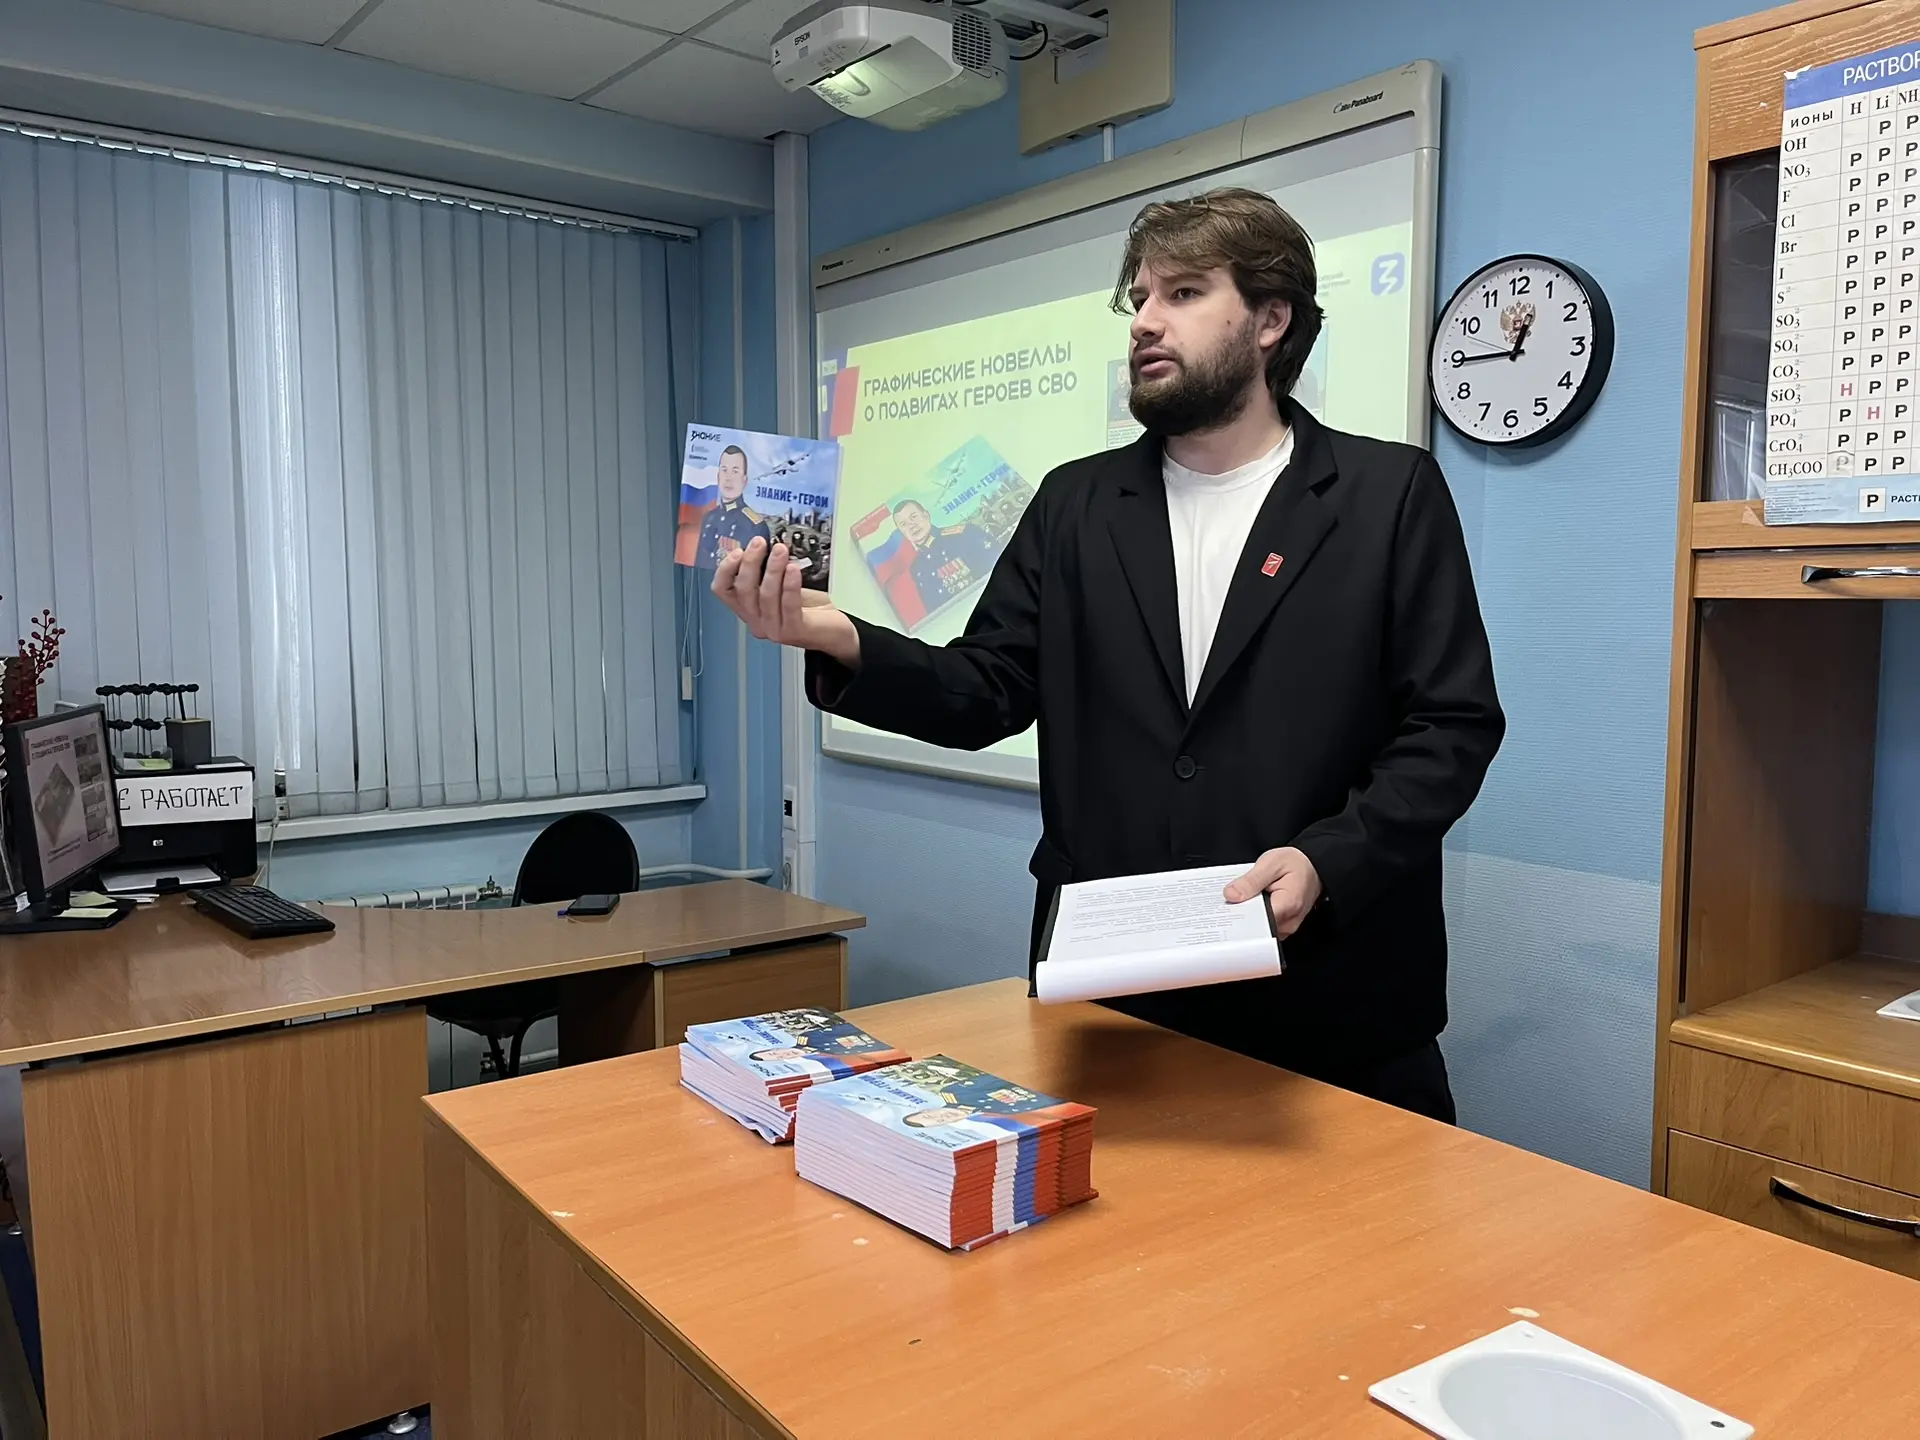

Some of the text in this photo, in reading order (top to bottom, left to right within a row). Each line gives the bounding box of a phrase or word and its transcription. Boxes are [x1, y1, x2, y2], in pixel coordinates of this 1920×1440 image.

[794, 31, 810, 46] EPSON
[1898, 88, 1920, 105] NH
[1509, 275, 1530, 296] 12
[1545, 281, 1553, 299] 1
[1482, 290, 1498, 308] 11
[1563, 302, 1577, 322] 2
[1460, 317, 1481, 336] 10
[1570, 336, 1585, 356] 3
[1451, 350, 1465, 368] 9
[864, 341, 1072, 397] ГРАФИЧЕСКИЕ НОВЕЛЛЫ
[1557, 371, 1573, 389] 4
[864, 371, 1078, 422] О ПОДВИГАХ ГЕРОЕВ СВО
[1457, 382, 1471, 399] 8
[1478, 402, 1491, 421] 7
[1533, 397, 1548, 416] 5
[1503, 410, 1519, 428] 6
[756, 486, 829, 508] ЗНАНИЕ ГЕРОИ
[1890, 494, 1920, 503] РАСТ
[140, 786, 243, 810] РАБОТАЕТ
